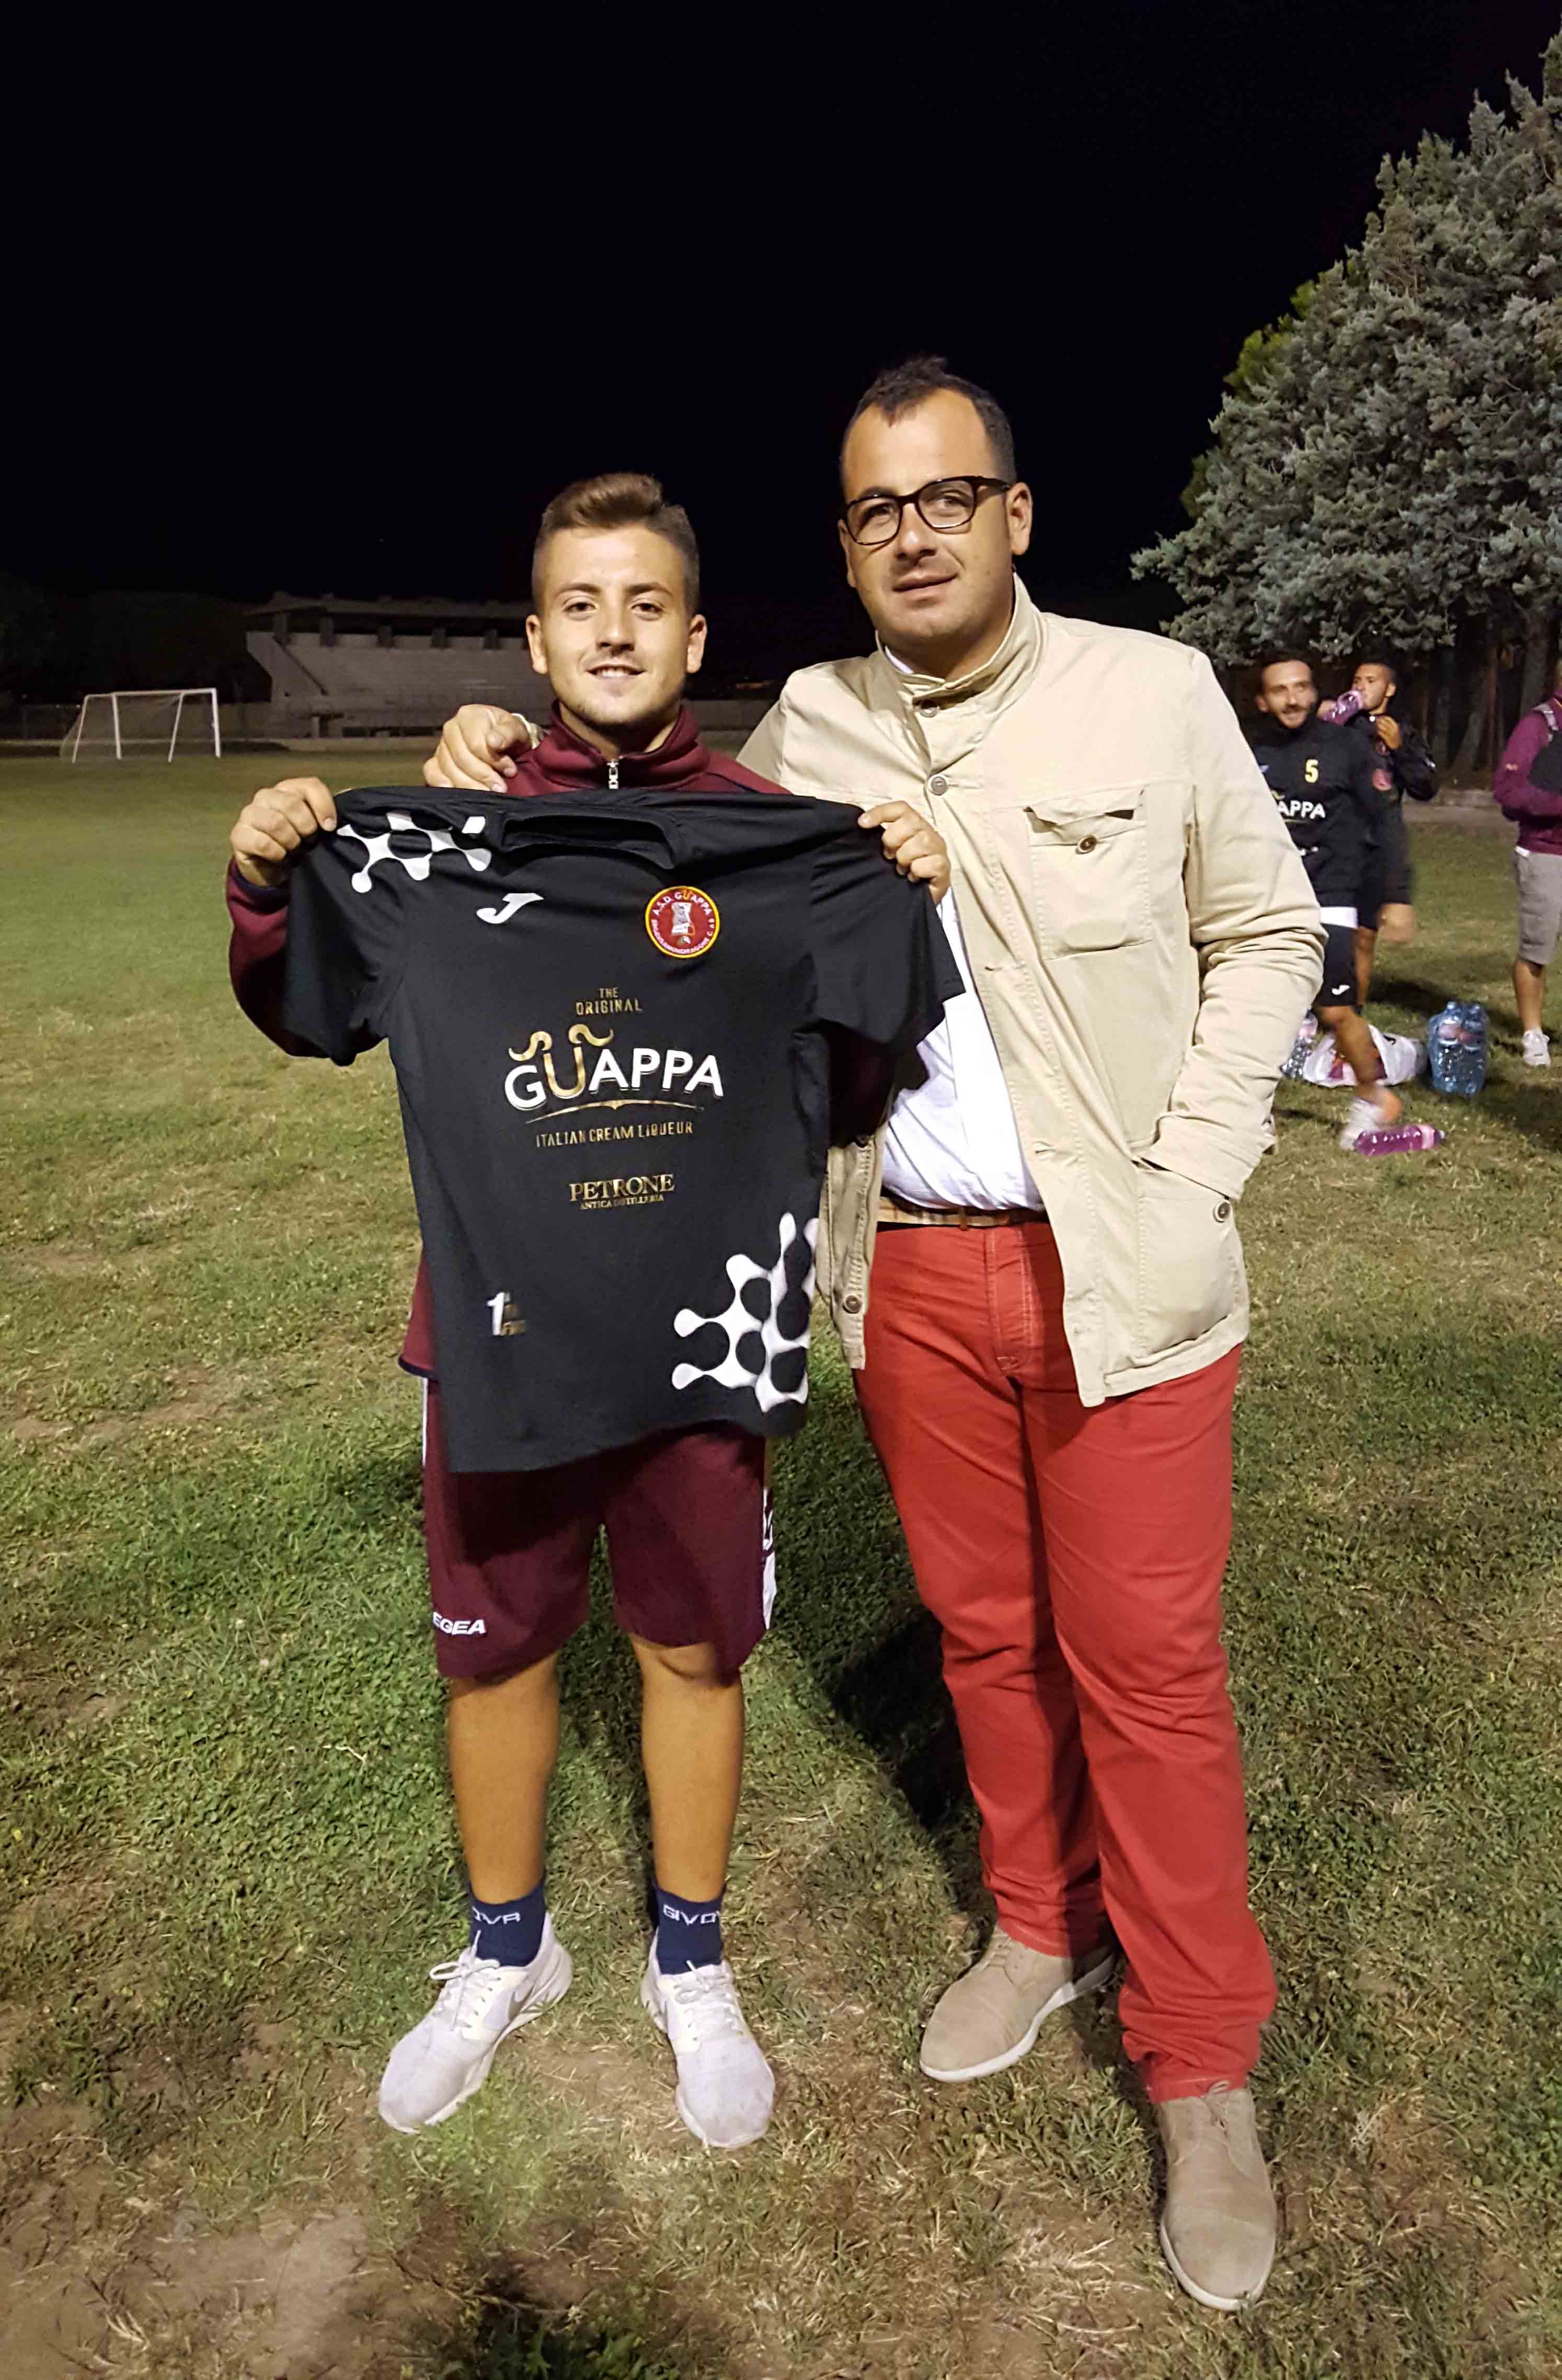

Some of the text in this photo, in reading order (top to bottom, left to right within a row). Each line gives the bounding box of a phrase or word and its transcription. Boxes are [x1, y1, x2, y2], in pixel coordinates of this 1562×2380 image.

[1305, 758, 1319, 783] 5
[1277, 800, 1326, 820] APPA
[674, 889, 713, 915] GUAPPA
[599, 987, 619, 998] THE
[576, 998, 643, 1016] ORIGINAL
[504, 1044, 725, 1111] GUAPPA
[536, 1121, 693, 1148] ITALIAN CREAM LIQUEUR
[569, 1174, 676, 1202] PETRONE
[432, 1611, 486, 1635] EGEA
